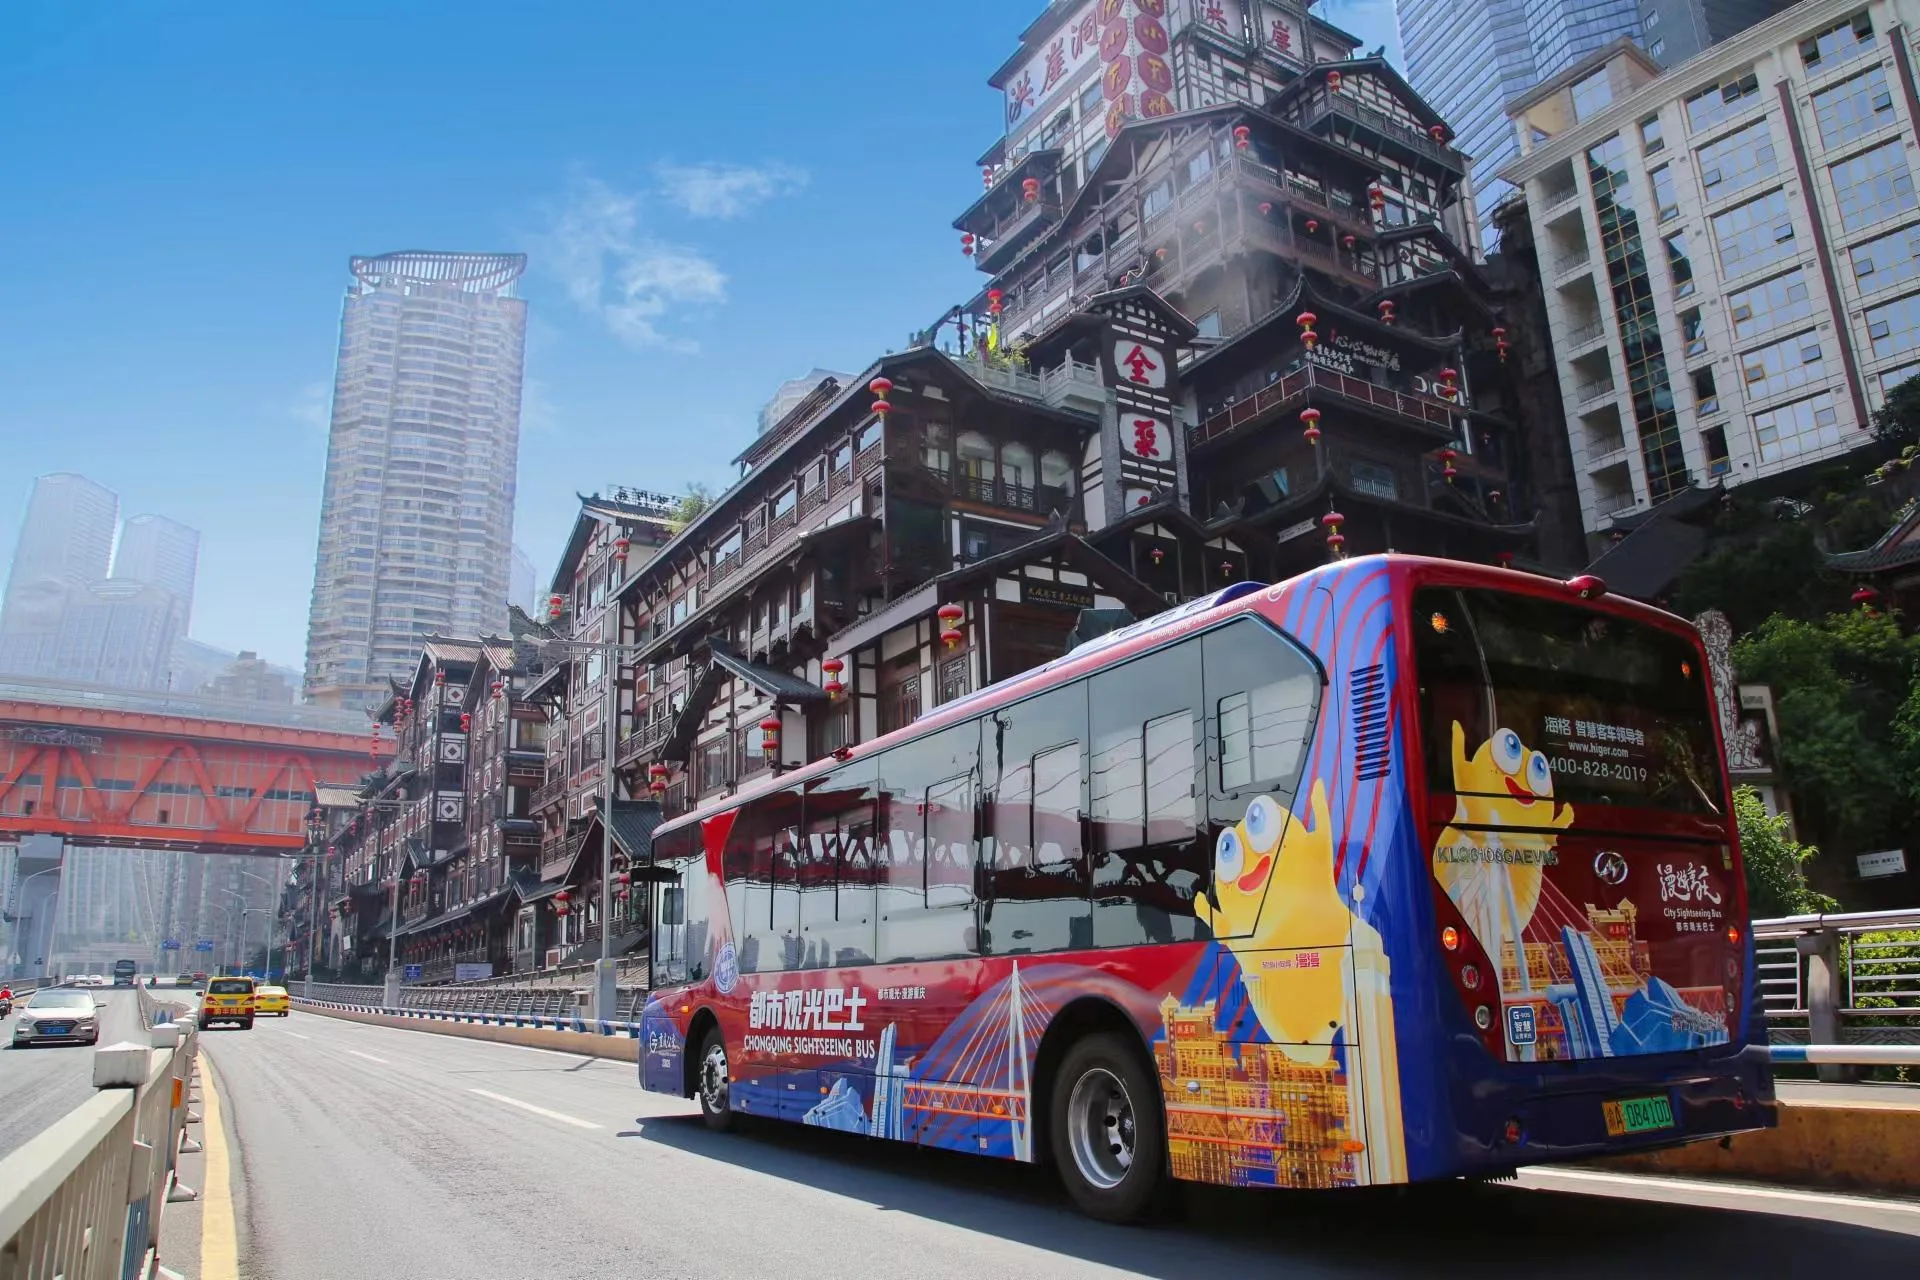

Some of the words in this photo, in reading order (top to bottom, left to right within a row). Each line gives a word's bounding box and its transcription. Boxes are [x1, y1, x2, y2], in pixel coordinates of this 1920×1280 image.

[1008, 11, 1101, 124] 洪崖洞
[1122, 344, 1160, 506] 全聚
[1544, 716, 1572, 736] 海格
[1575, 720, 1645, 747] 智慧客车领导者
[1568, 742, 1629, 758] www.higer.com
[1549, 757, 1647, 782] 400-828-2019
[1663, 908, 1676, 919] City
[1676, 908, 1711, 920] Sightseeing
[1711, 909, 1722, 918] Bus
[749, 986, 867, 1031] 都市观光巴士
[744, 1034, 792, 1056] CHONGQING
[793, 1036, 853, 1058] SIGHTSEEING
[855, 1039, 876, 1060] BUS
